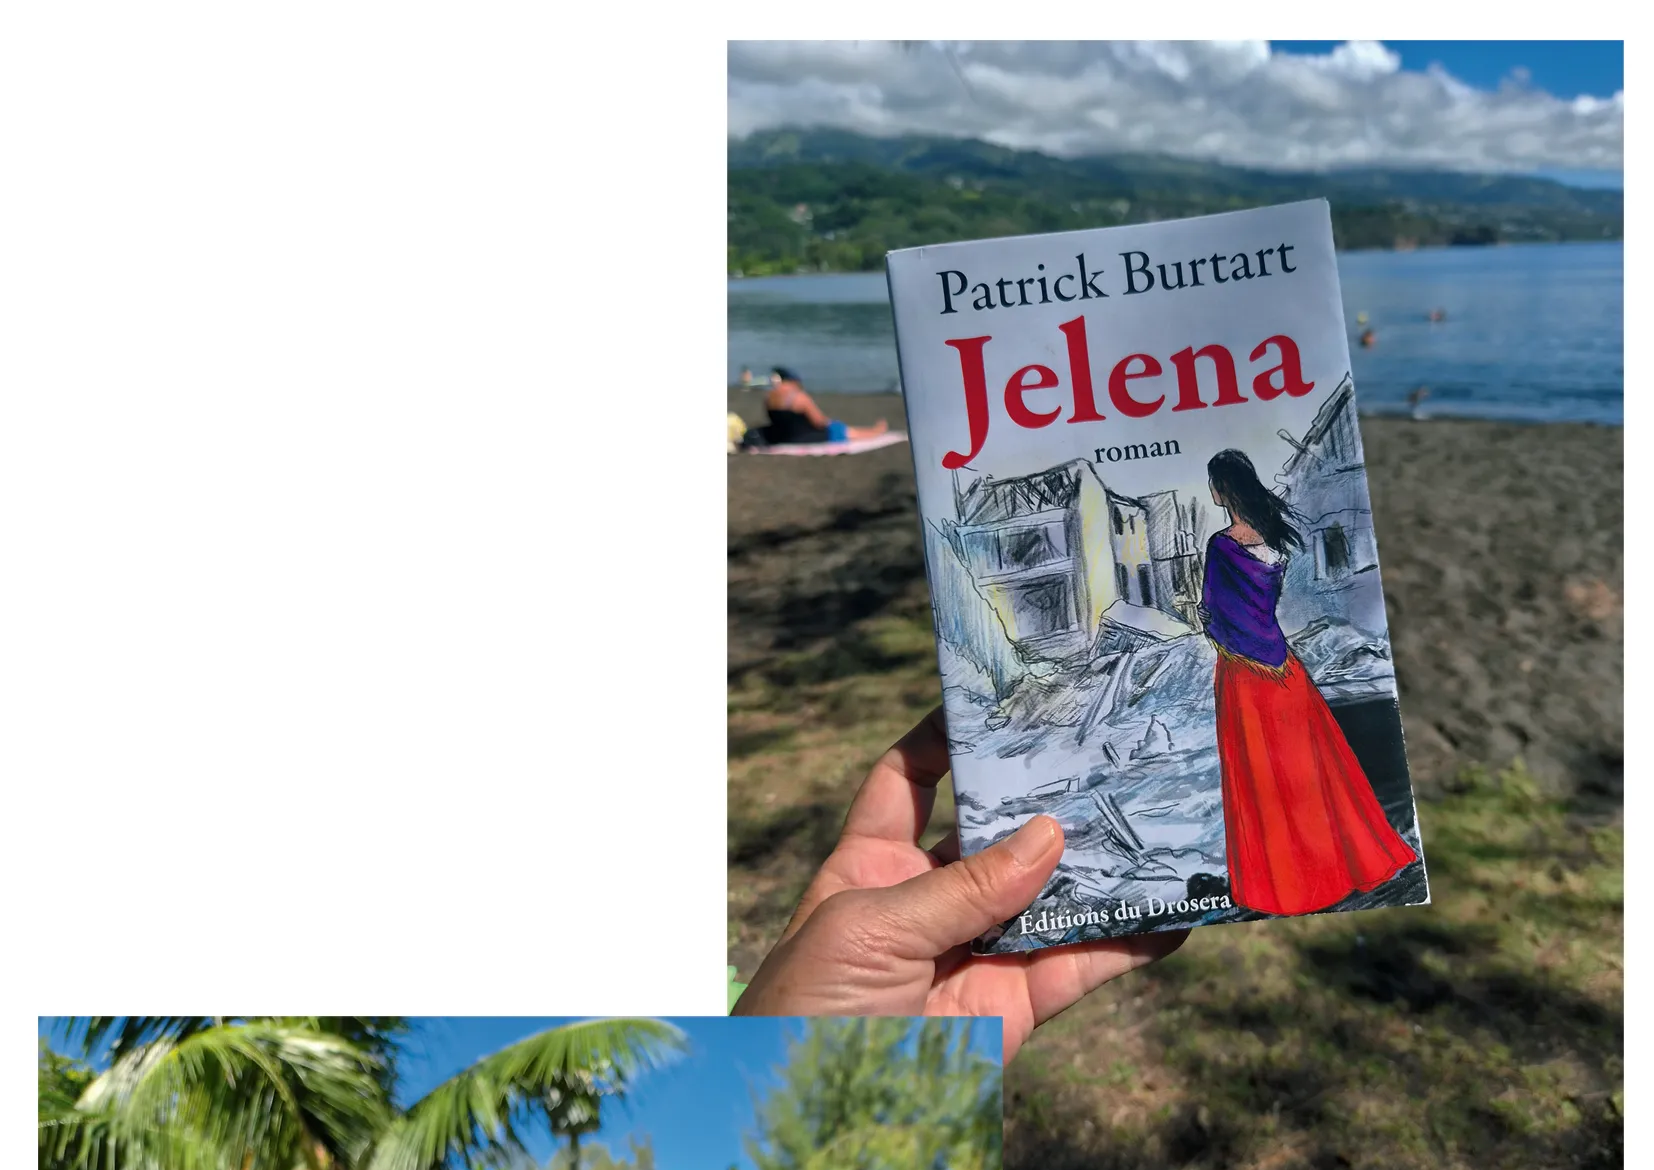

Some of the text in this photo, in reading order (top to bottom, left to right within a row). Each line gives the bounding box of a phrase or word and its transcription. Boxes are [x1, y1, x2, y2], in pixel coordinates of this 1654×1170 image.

[936, 241, 1298, 315] Patrick Burtart
[941, 315, 1315, 470] Jelena
[1094, 439, 1182, 464] roman
[1019, 894, 1232, 935] Éditions du Drosera
